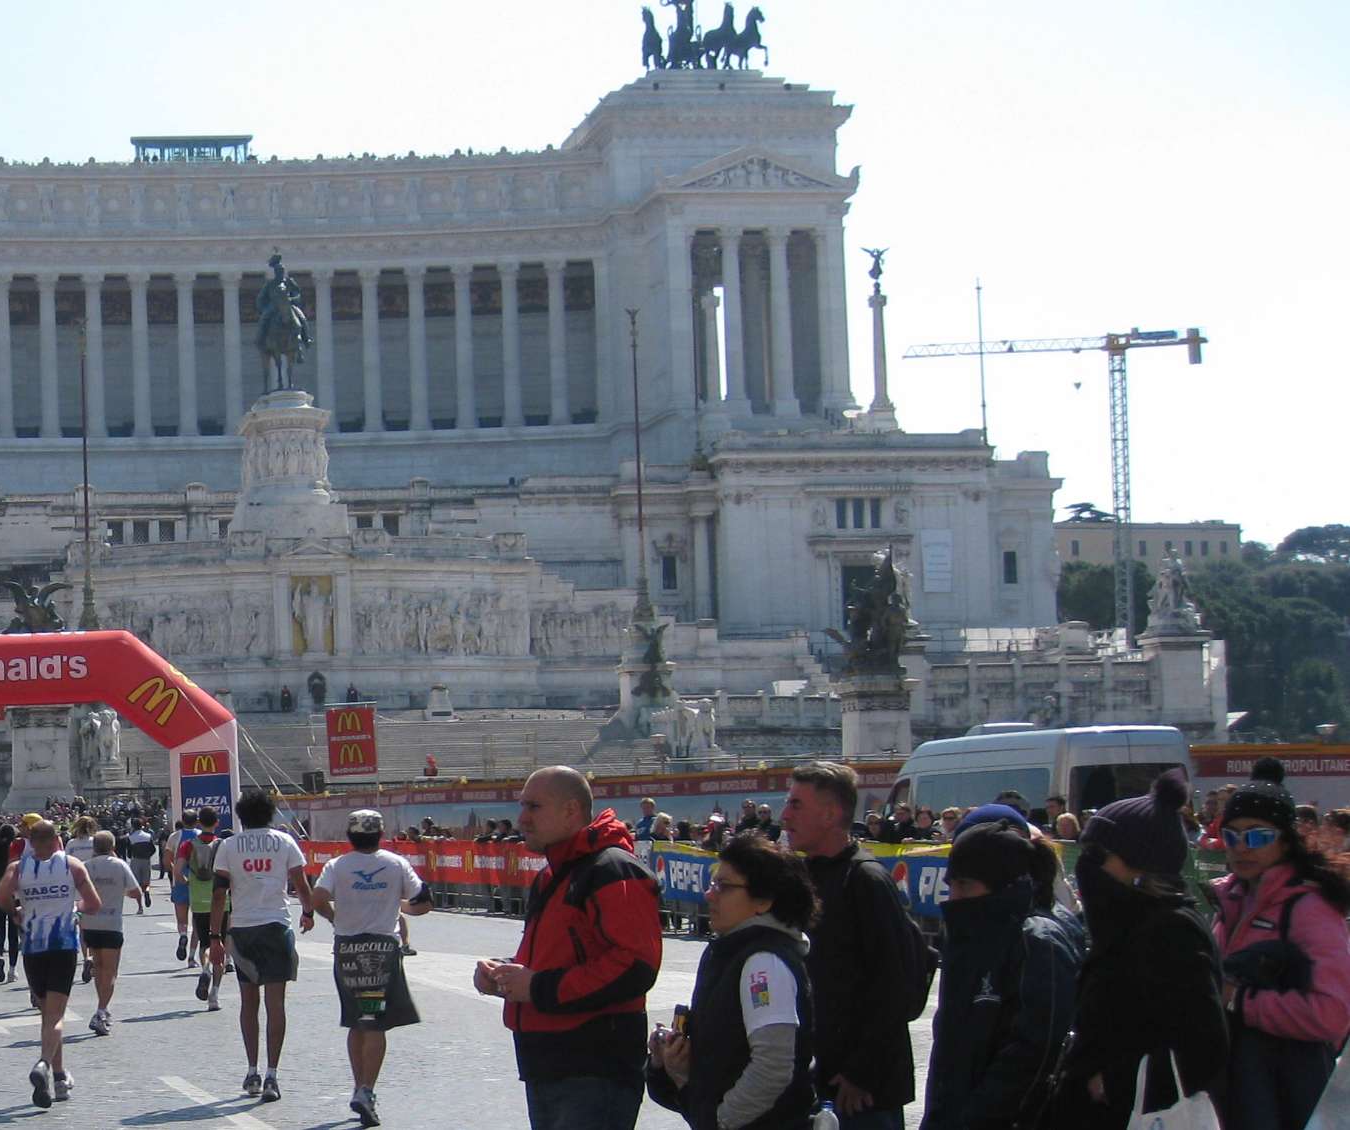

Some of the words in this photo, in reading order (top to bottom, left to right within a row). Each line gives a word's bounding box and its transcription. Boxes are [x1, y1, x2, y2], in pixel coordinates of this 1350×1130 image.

[1281, 759, 1350, 773] ROPOLITANE
[185, 796, 228, 807] PIAZZA
[237, 834, 280, 853] MEXICO
[243, 859, 272, 872] GUS
[668, 860, 705, 893] PEPSI
